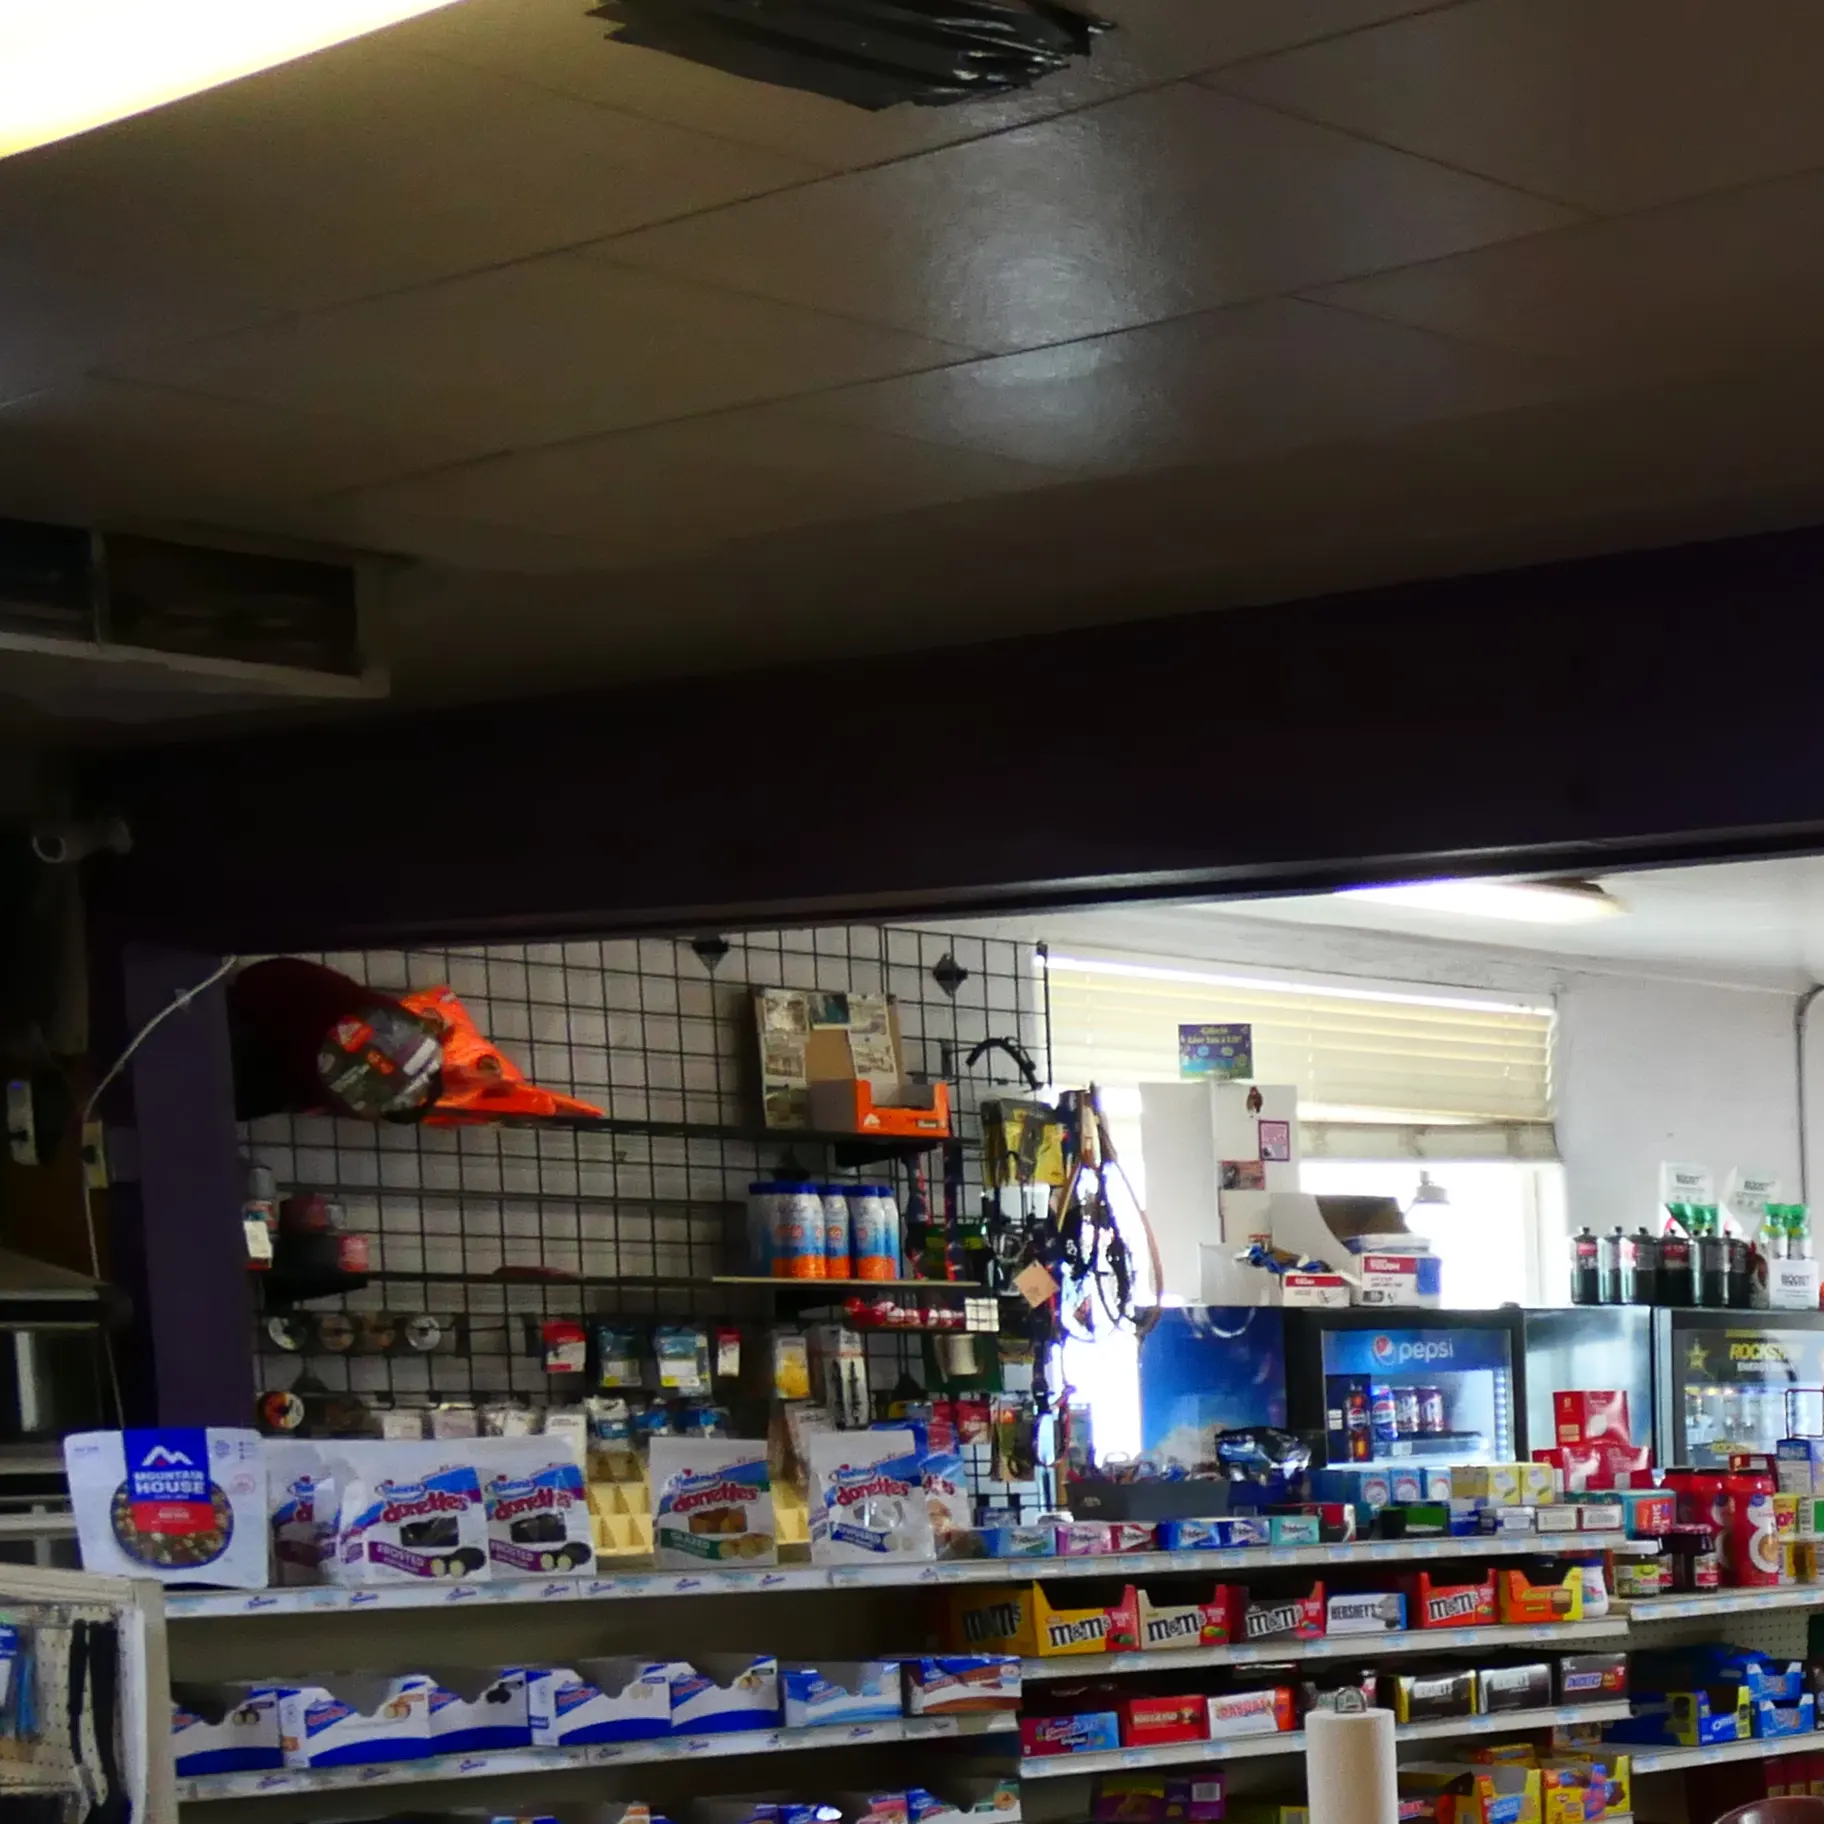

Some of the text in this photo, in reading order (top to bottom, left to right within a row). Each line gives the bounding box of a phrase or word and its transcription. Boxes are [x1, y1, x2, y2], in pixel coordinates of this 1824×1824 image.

[1399, 1337, 1454, 1363] pepsi
[133, 1470, 205, 1483] MOUNTAIN
[135, 1480, 206, 1495] HOUSE
